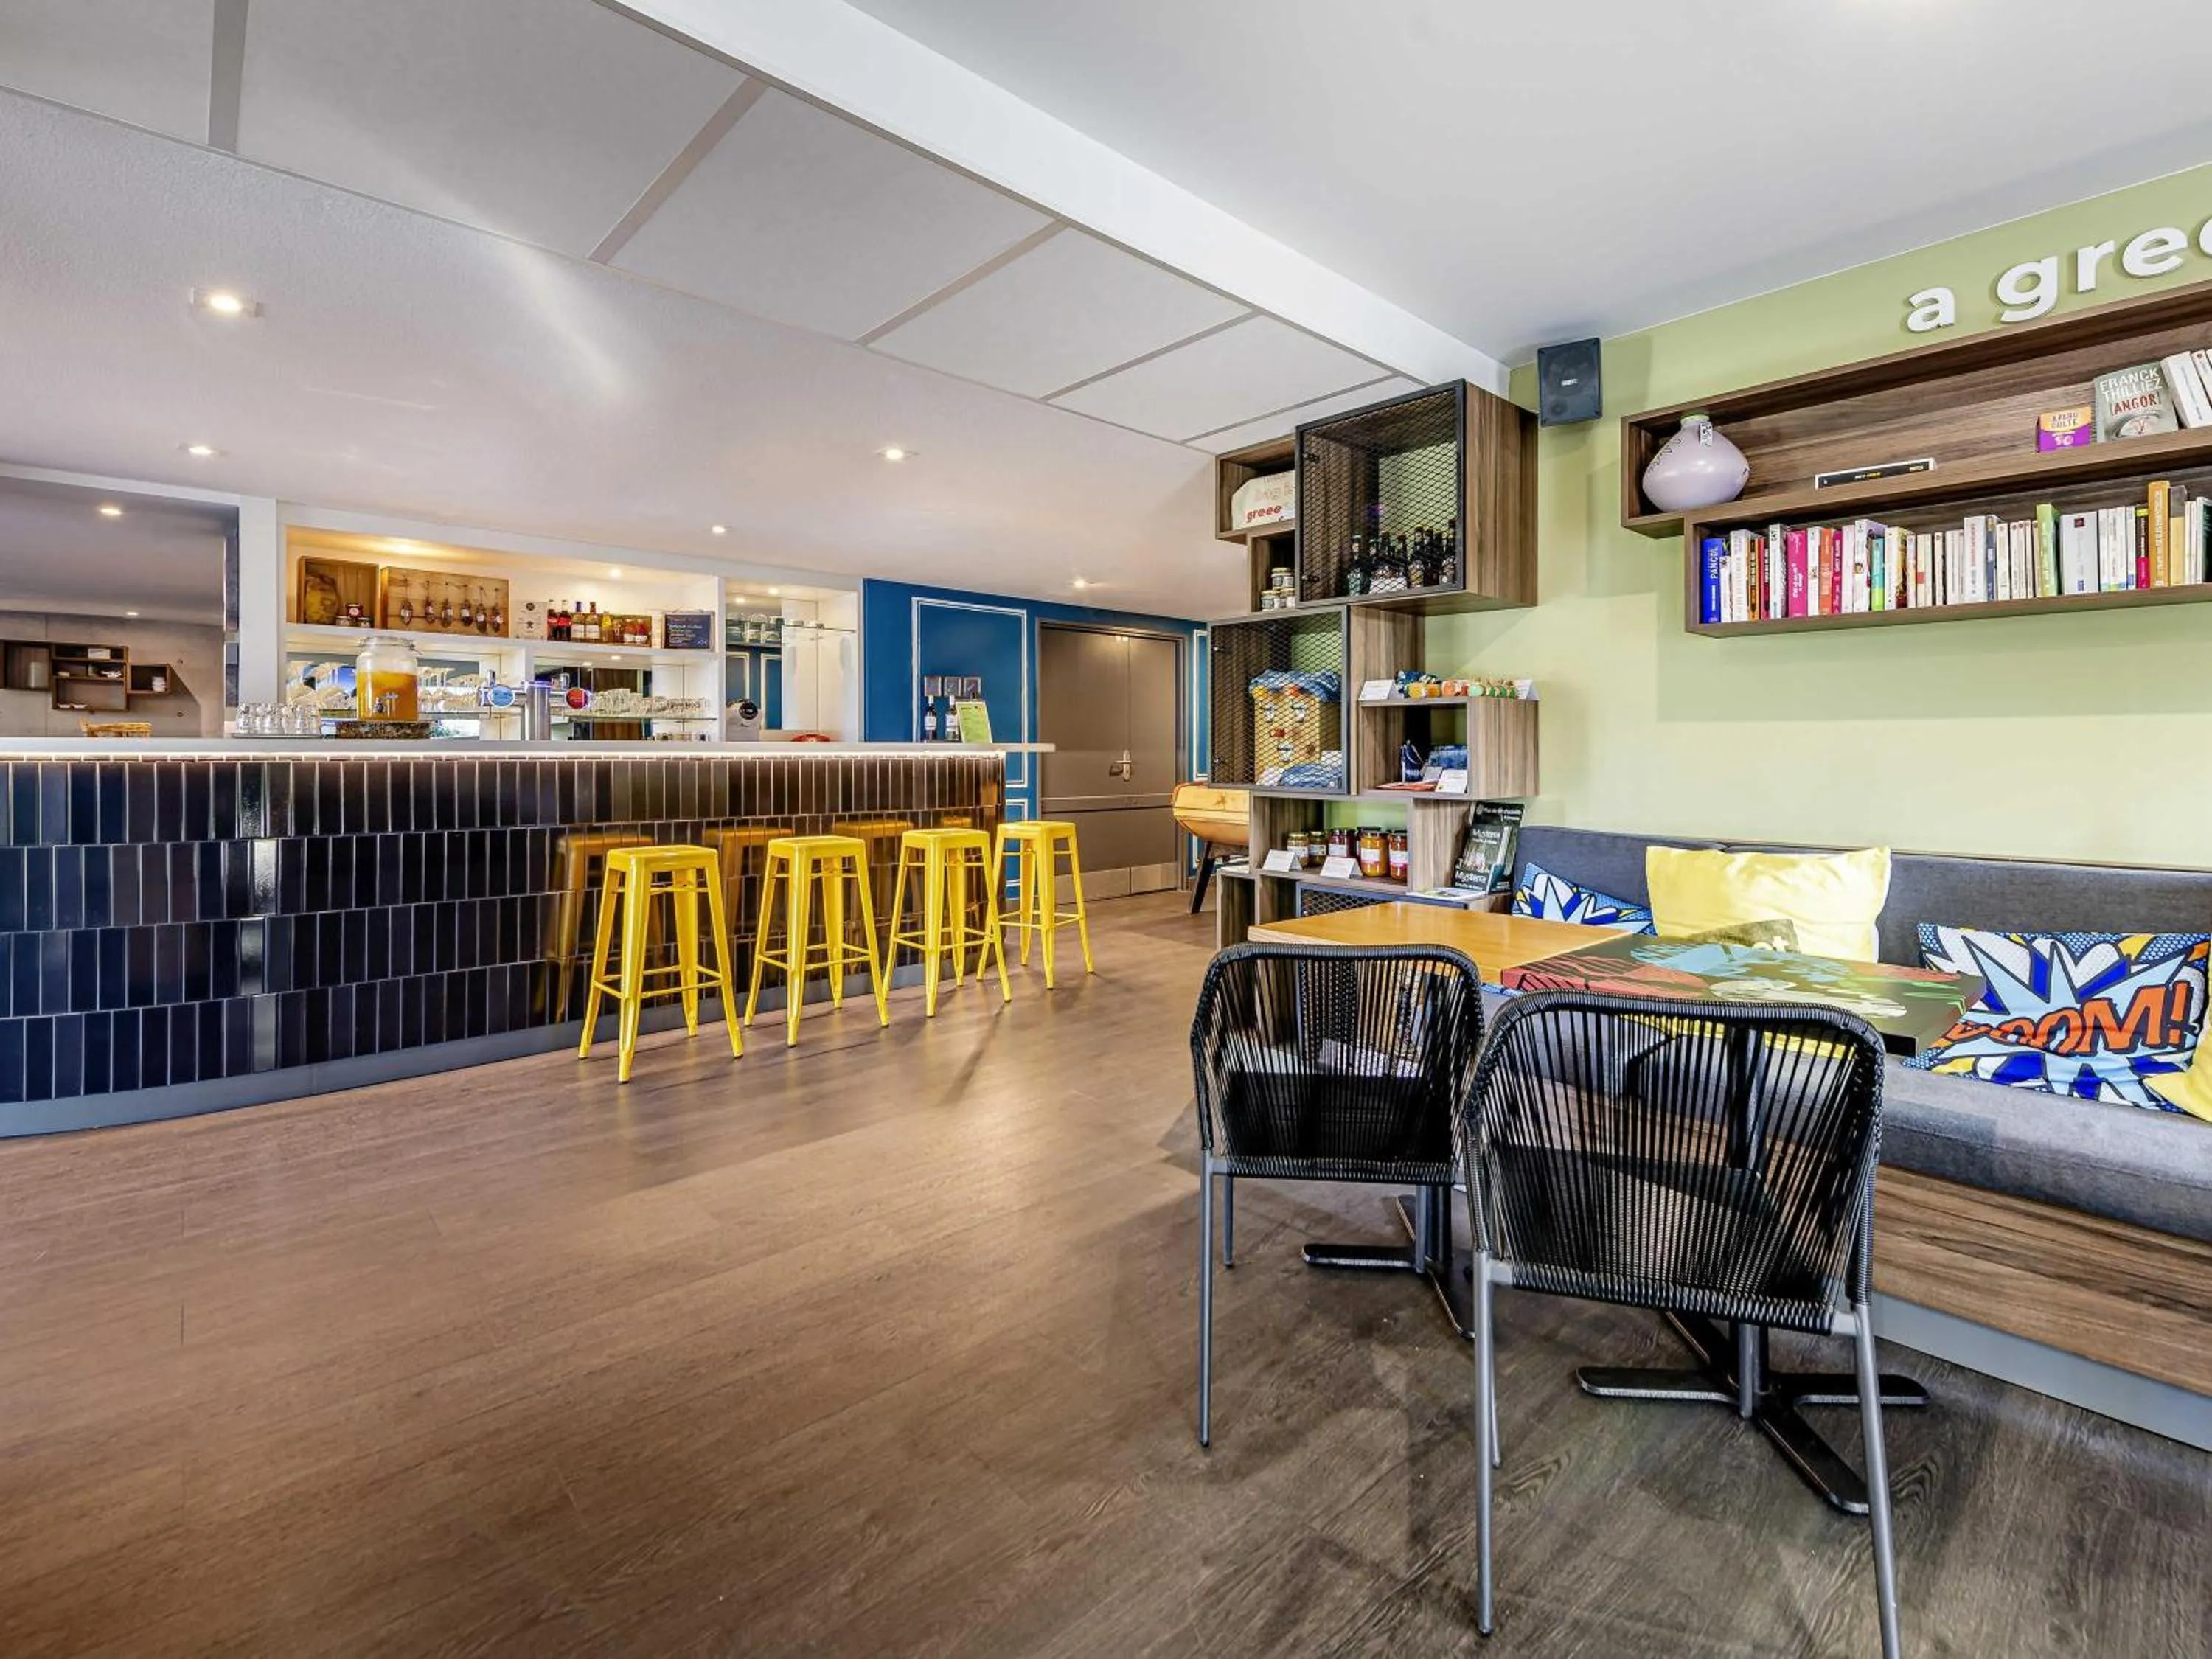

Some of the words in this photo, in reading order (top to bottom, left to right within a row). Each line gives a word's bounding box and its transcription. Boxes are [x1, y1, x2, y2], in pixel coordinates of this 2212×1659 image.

[1907, 286, 1955, 333] a
[1995, 215, 2212, 324] gre
[2099, 368, 2160, 393] FRANCK
[1709, 545, 1719, 580] PANCOL
